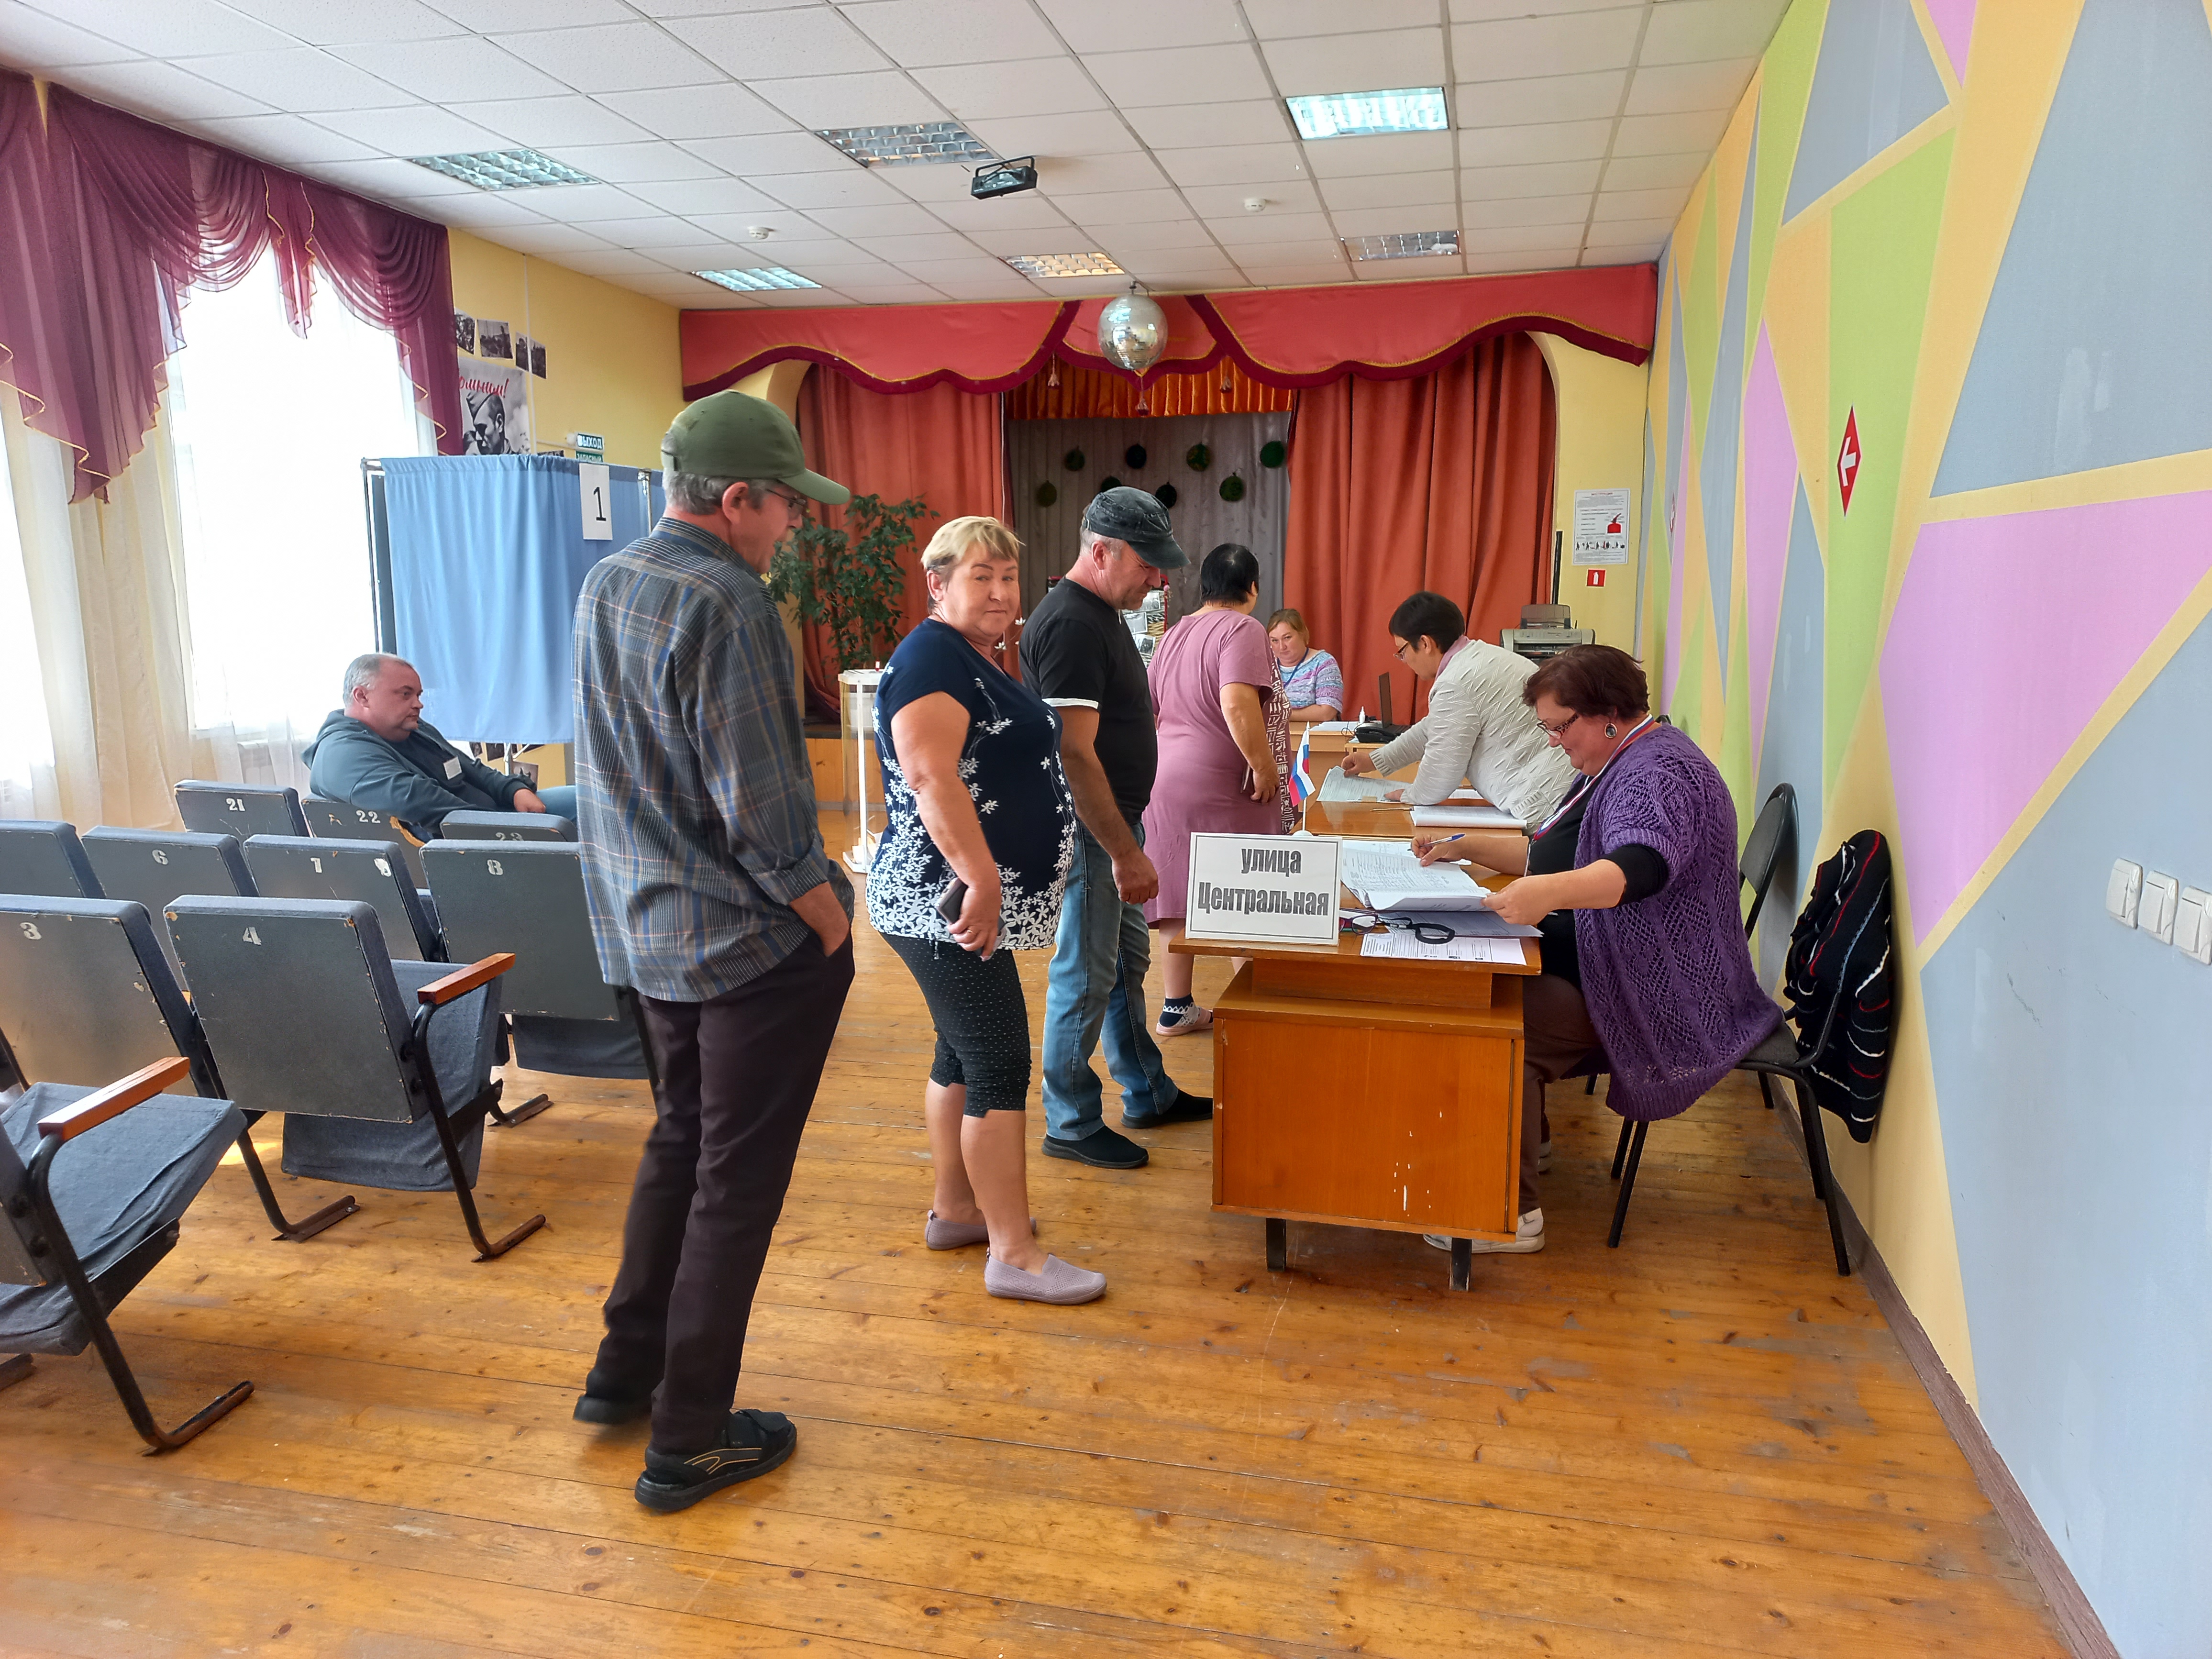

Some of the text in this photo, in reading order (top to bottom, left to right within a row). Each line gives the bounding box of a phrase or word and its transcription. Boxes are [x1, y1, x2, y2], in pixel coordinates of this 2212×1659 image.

[577, 435, 602, 449] ВЫХОД
[594, 487, 607, 521] 1
[226, 798, 245, 811] 21
[356, 810, 381, 823] 22
[496, 832, 524, 841] 23
[152, 849, 168, 864] 6
[1241, 849, 1302, 877] улица
[487, 860, 503, 875] 8
[1198, 882, 1329, 916] Центральная
[20, 922, 42, 940] 3
[243, 927, 262, 945] 4
